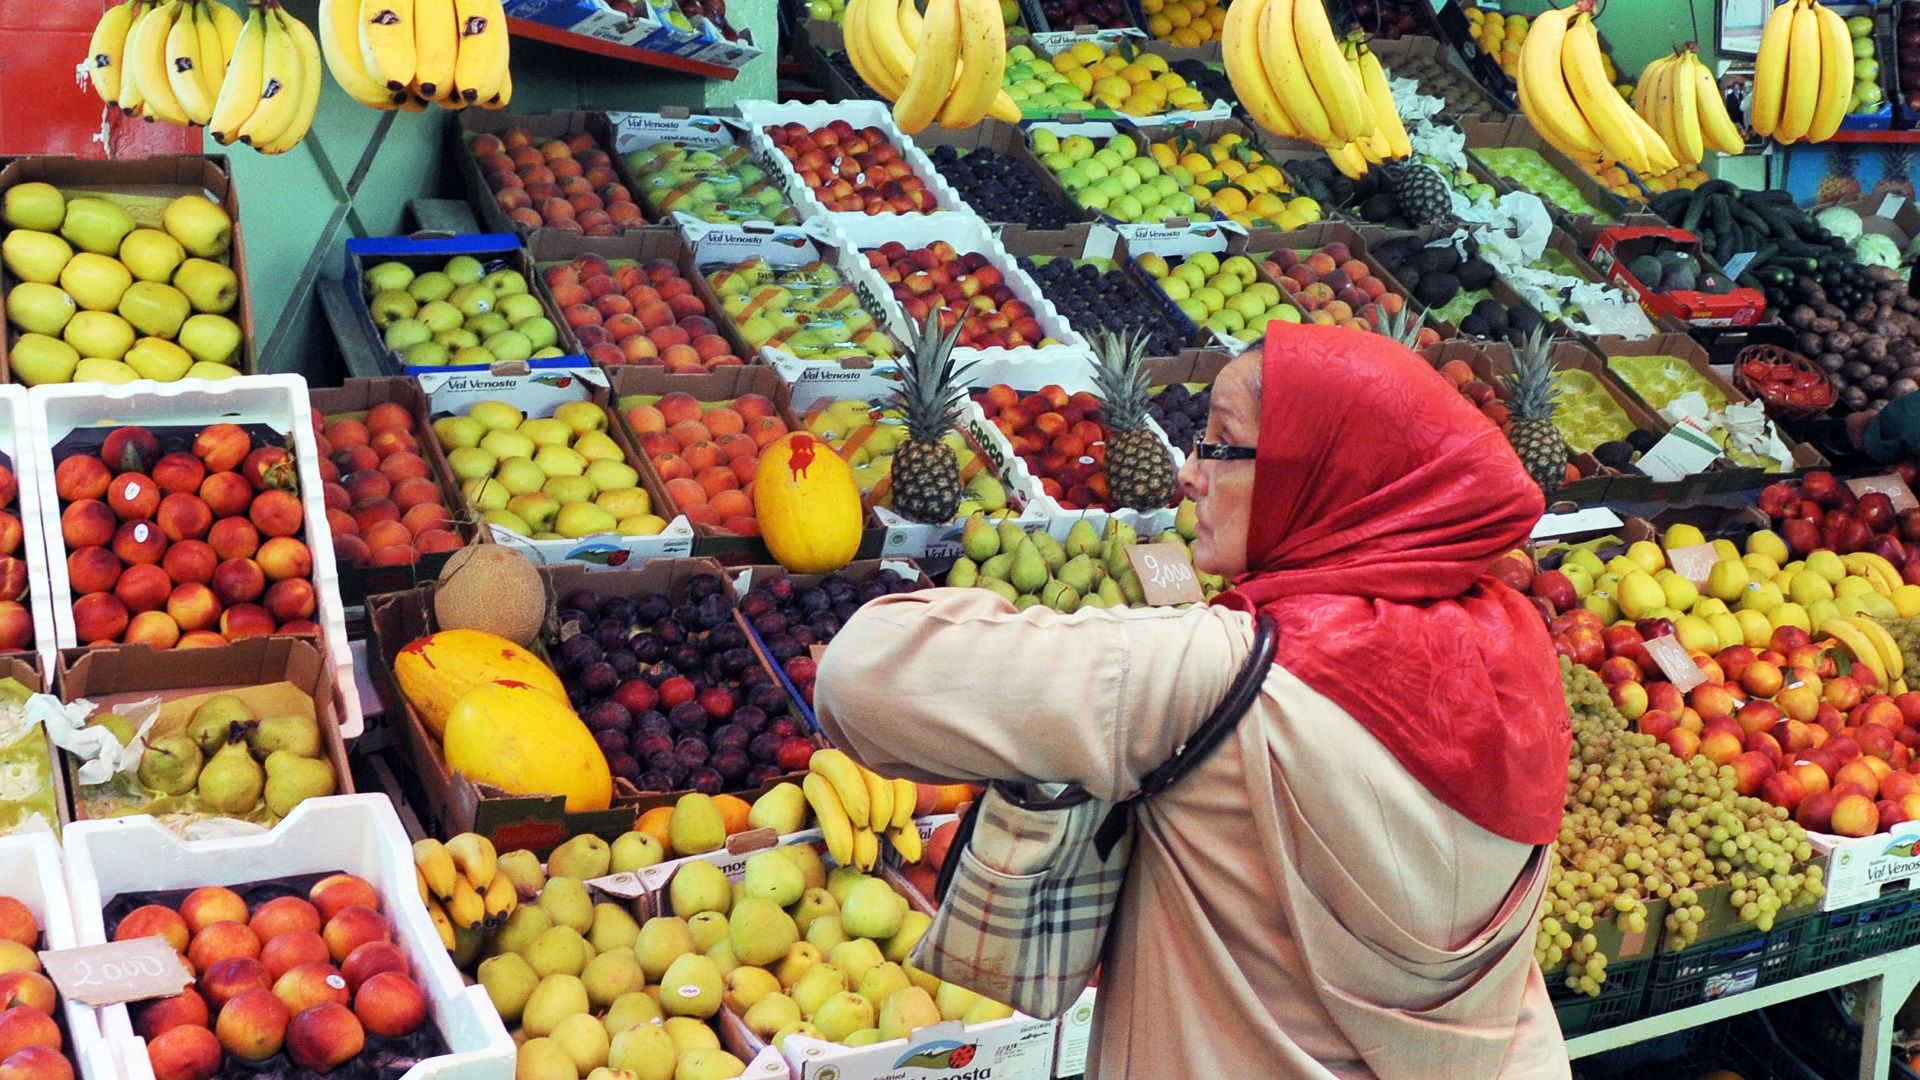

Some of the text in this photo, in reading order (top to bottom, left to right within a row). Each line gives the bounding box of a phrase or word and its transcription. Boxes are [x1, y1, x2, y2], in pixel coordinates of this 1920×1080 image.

[628, 119, 679, 129] Val Venosta
[708, 233, 762, 244] Val Venosta
[803, 371, 860, 380] Val Venosta
[448, 379, 517, 390] Val Venosta
[970, 419, 1004, 468] CROCO
[1867, 864, 1885, 880] Val
